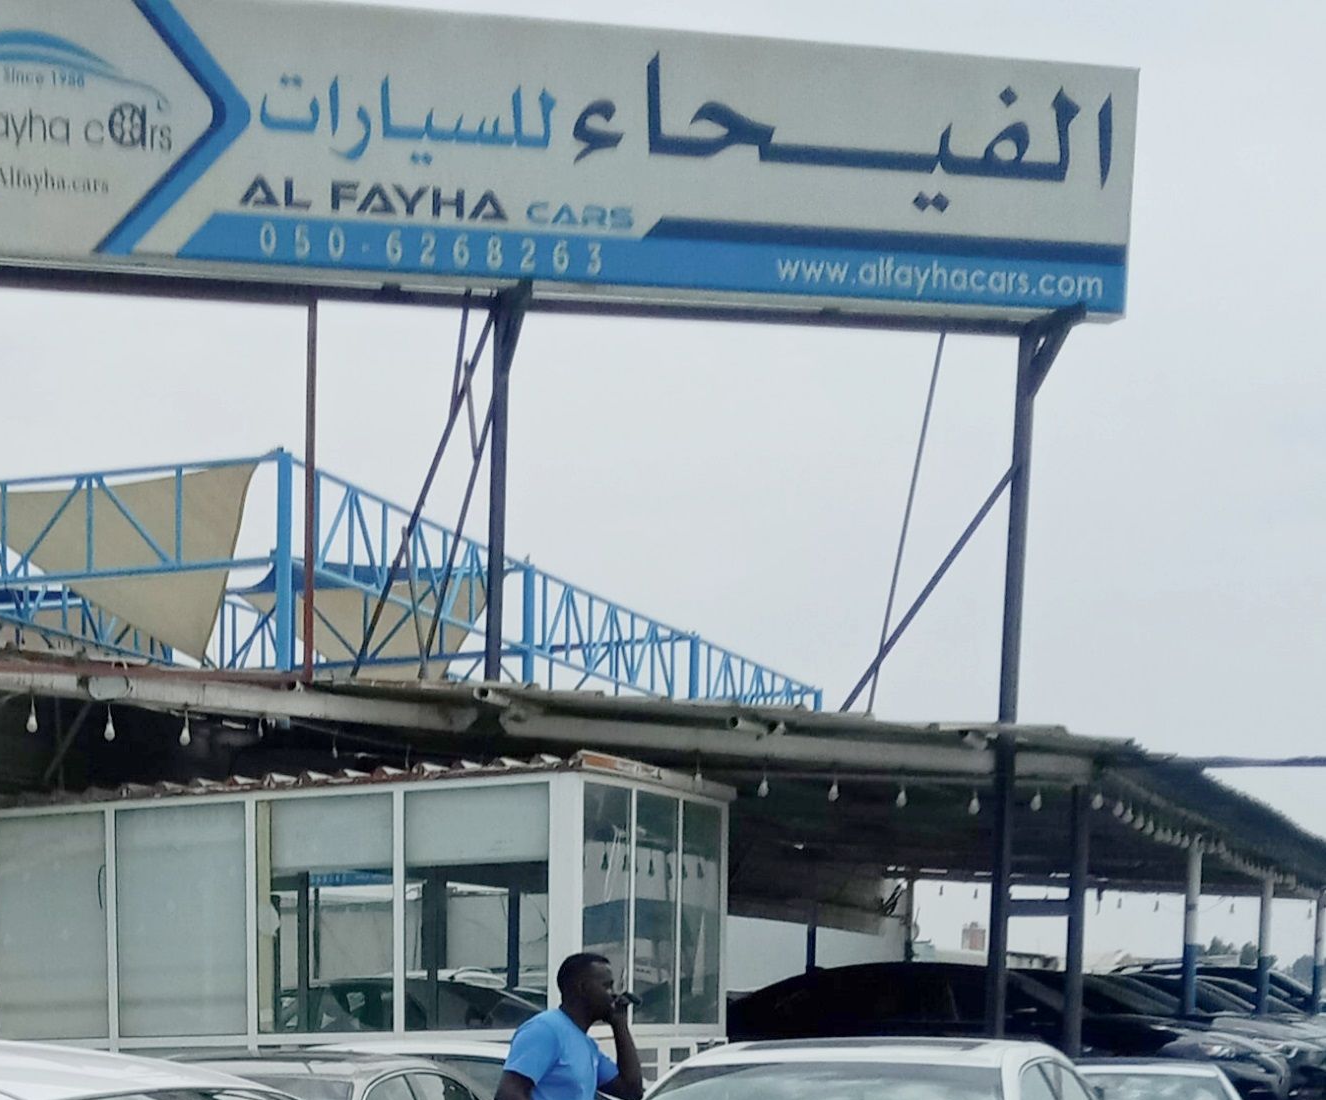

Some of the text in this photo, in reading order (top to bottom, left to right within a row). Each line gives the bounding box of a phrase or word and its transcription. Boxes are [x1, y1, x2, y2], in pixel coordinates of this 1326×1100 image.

[84, 102, 171, 151] cars
[260, 51, 1112, 212] الفيحاء للسيارات
[241, 175, 634, 231] AL FAYHA CARS
[777, 256, 1104, 298] www.alfayhacars.com
